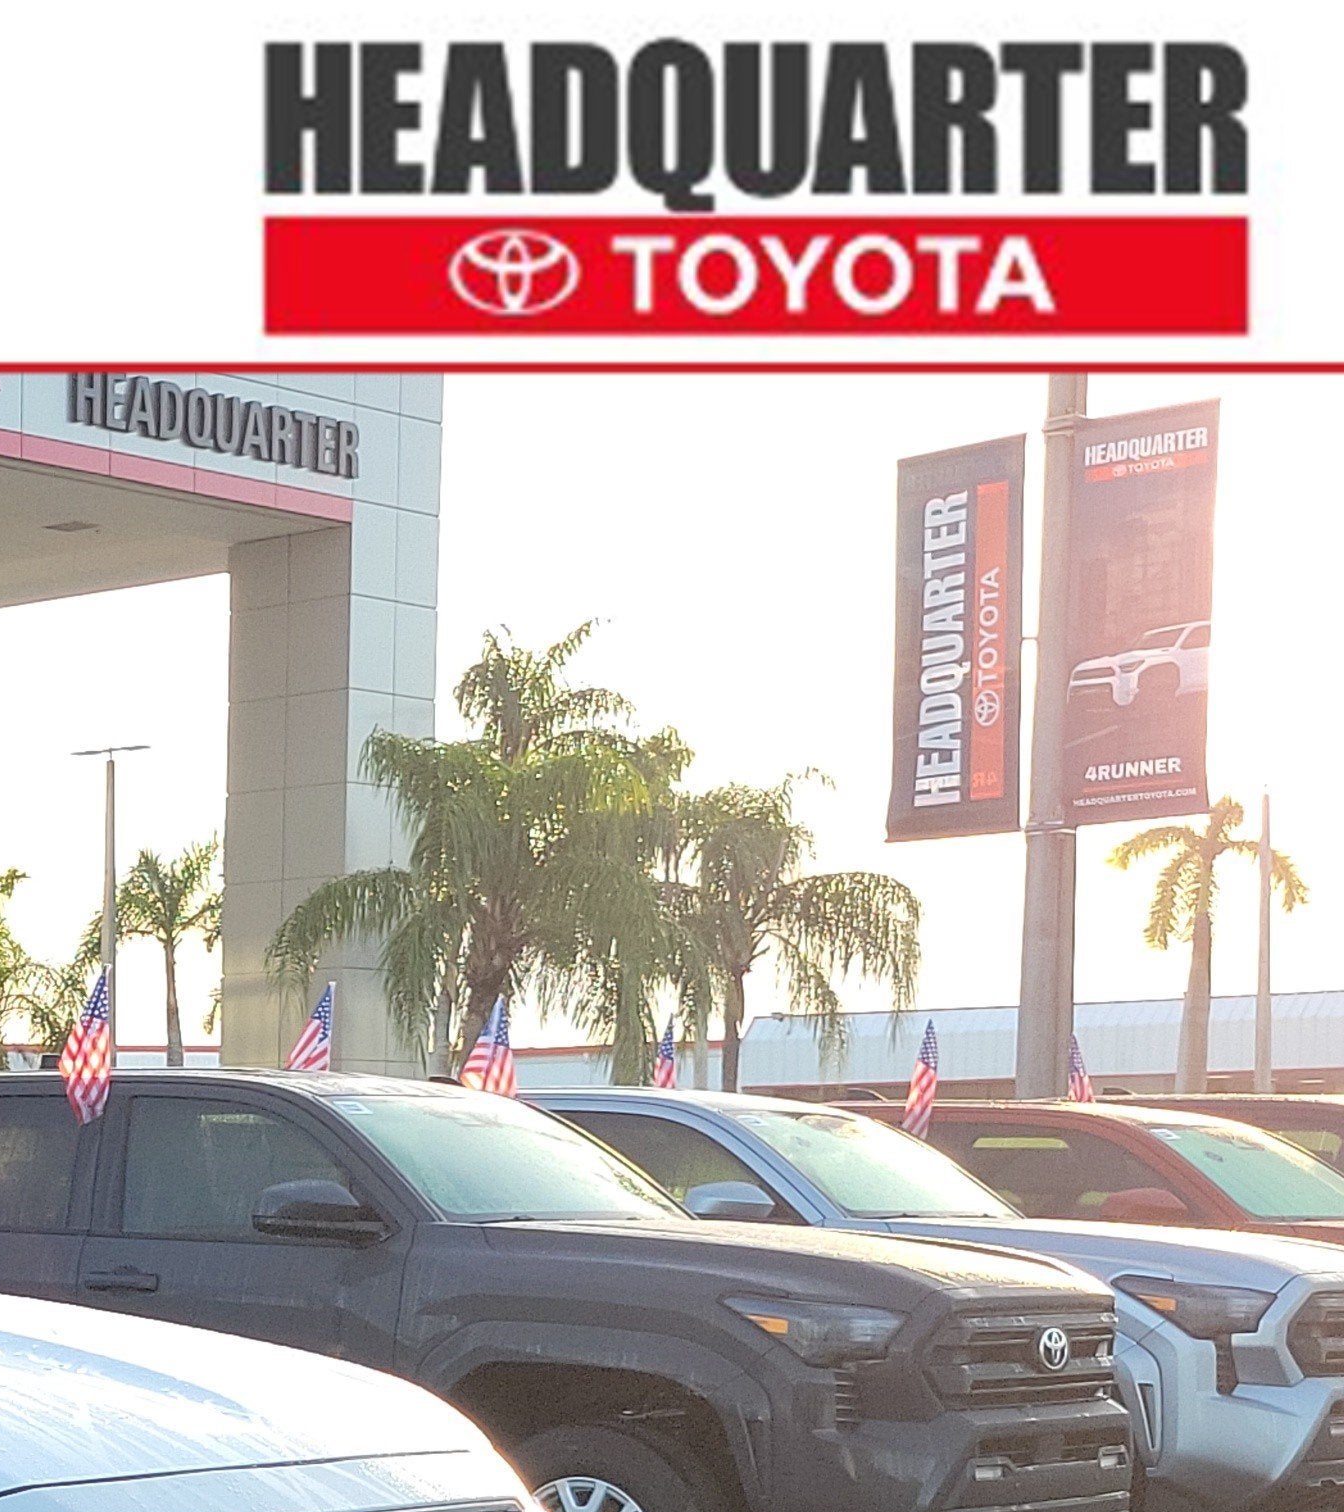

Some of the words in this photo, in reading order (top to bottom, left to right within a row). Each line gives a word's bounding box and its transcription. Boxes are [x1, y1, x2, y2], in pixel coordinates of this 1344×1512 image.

[67, 372, 359, 478] HEADQUARTER
[1084, 426, 1208, 467] HEADQUARTER
[1127, 457, 1175, 475] TOYOTA
[974, 566, 1000, 688] TOYOTA
[914, 489, 970, 807] HEADQUARTER
[1084, 757, 1182, 782] 4RUNNER
[1072, 787, 1198, 808] HEADQUARTERTOYOTA.COM
